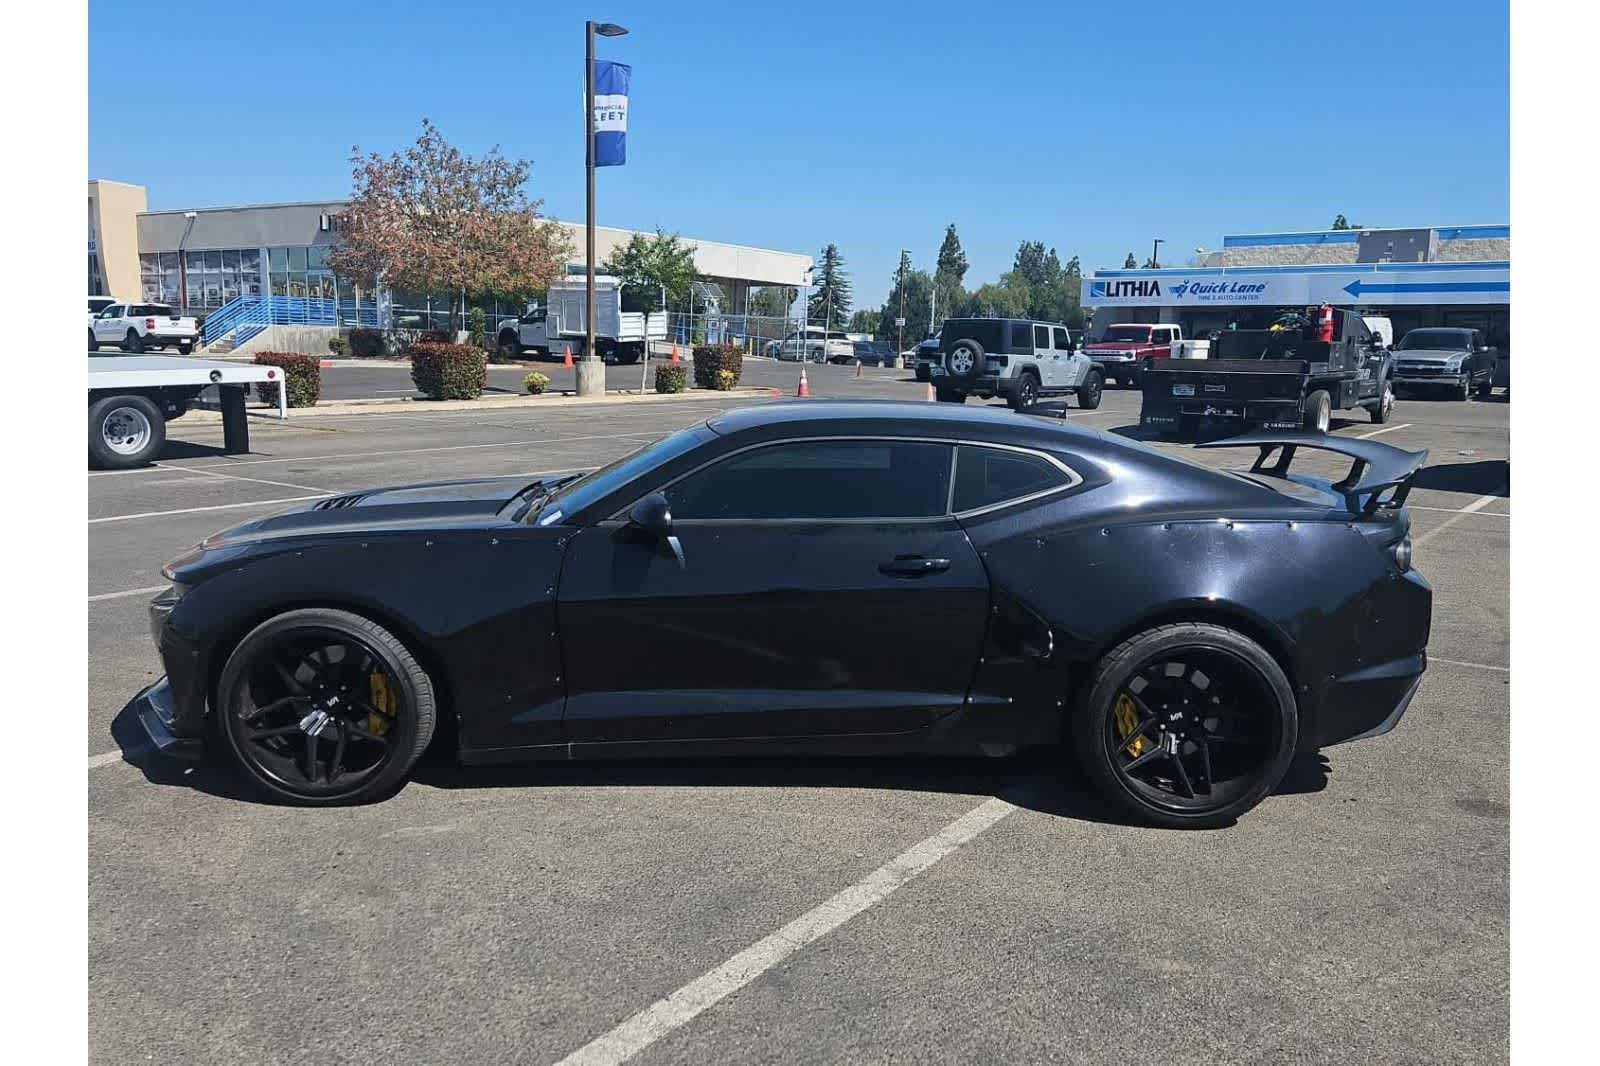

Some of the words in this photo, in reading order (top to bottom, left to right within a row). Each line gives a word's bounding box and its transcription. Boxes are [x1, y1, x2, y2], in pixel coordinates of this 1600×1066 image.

[1106, 280, 1161, 297] LITHIA
[1190, 282, 1229, 295] Quick
[1230, 281, 1266, 293] Lane
